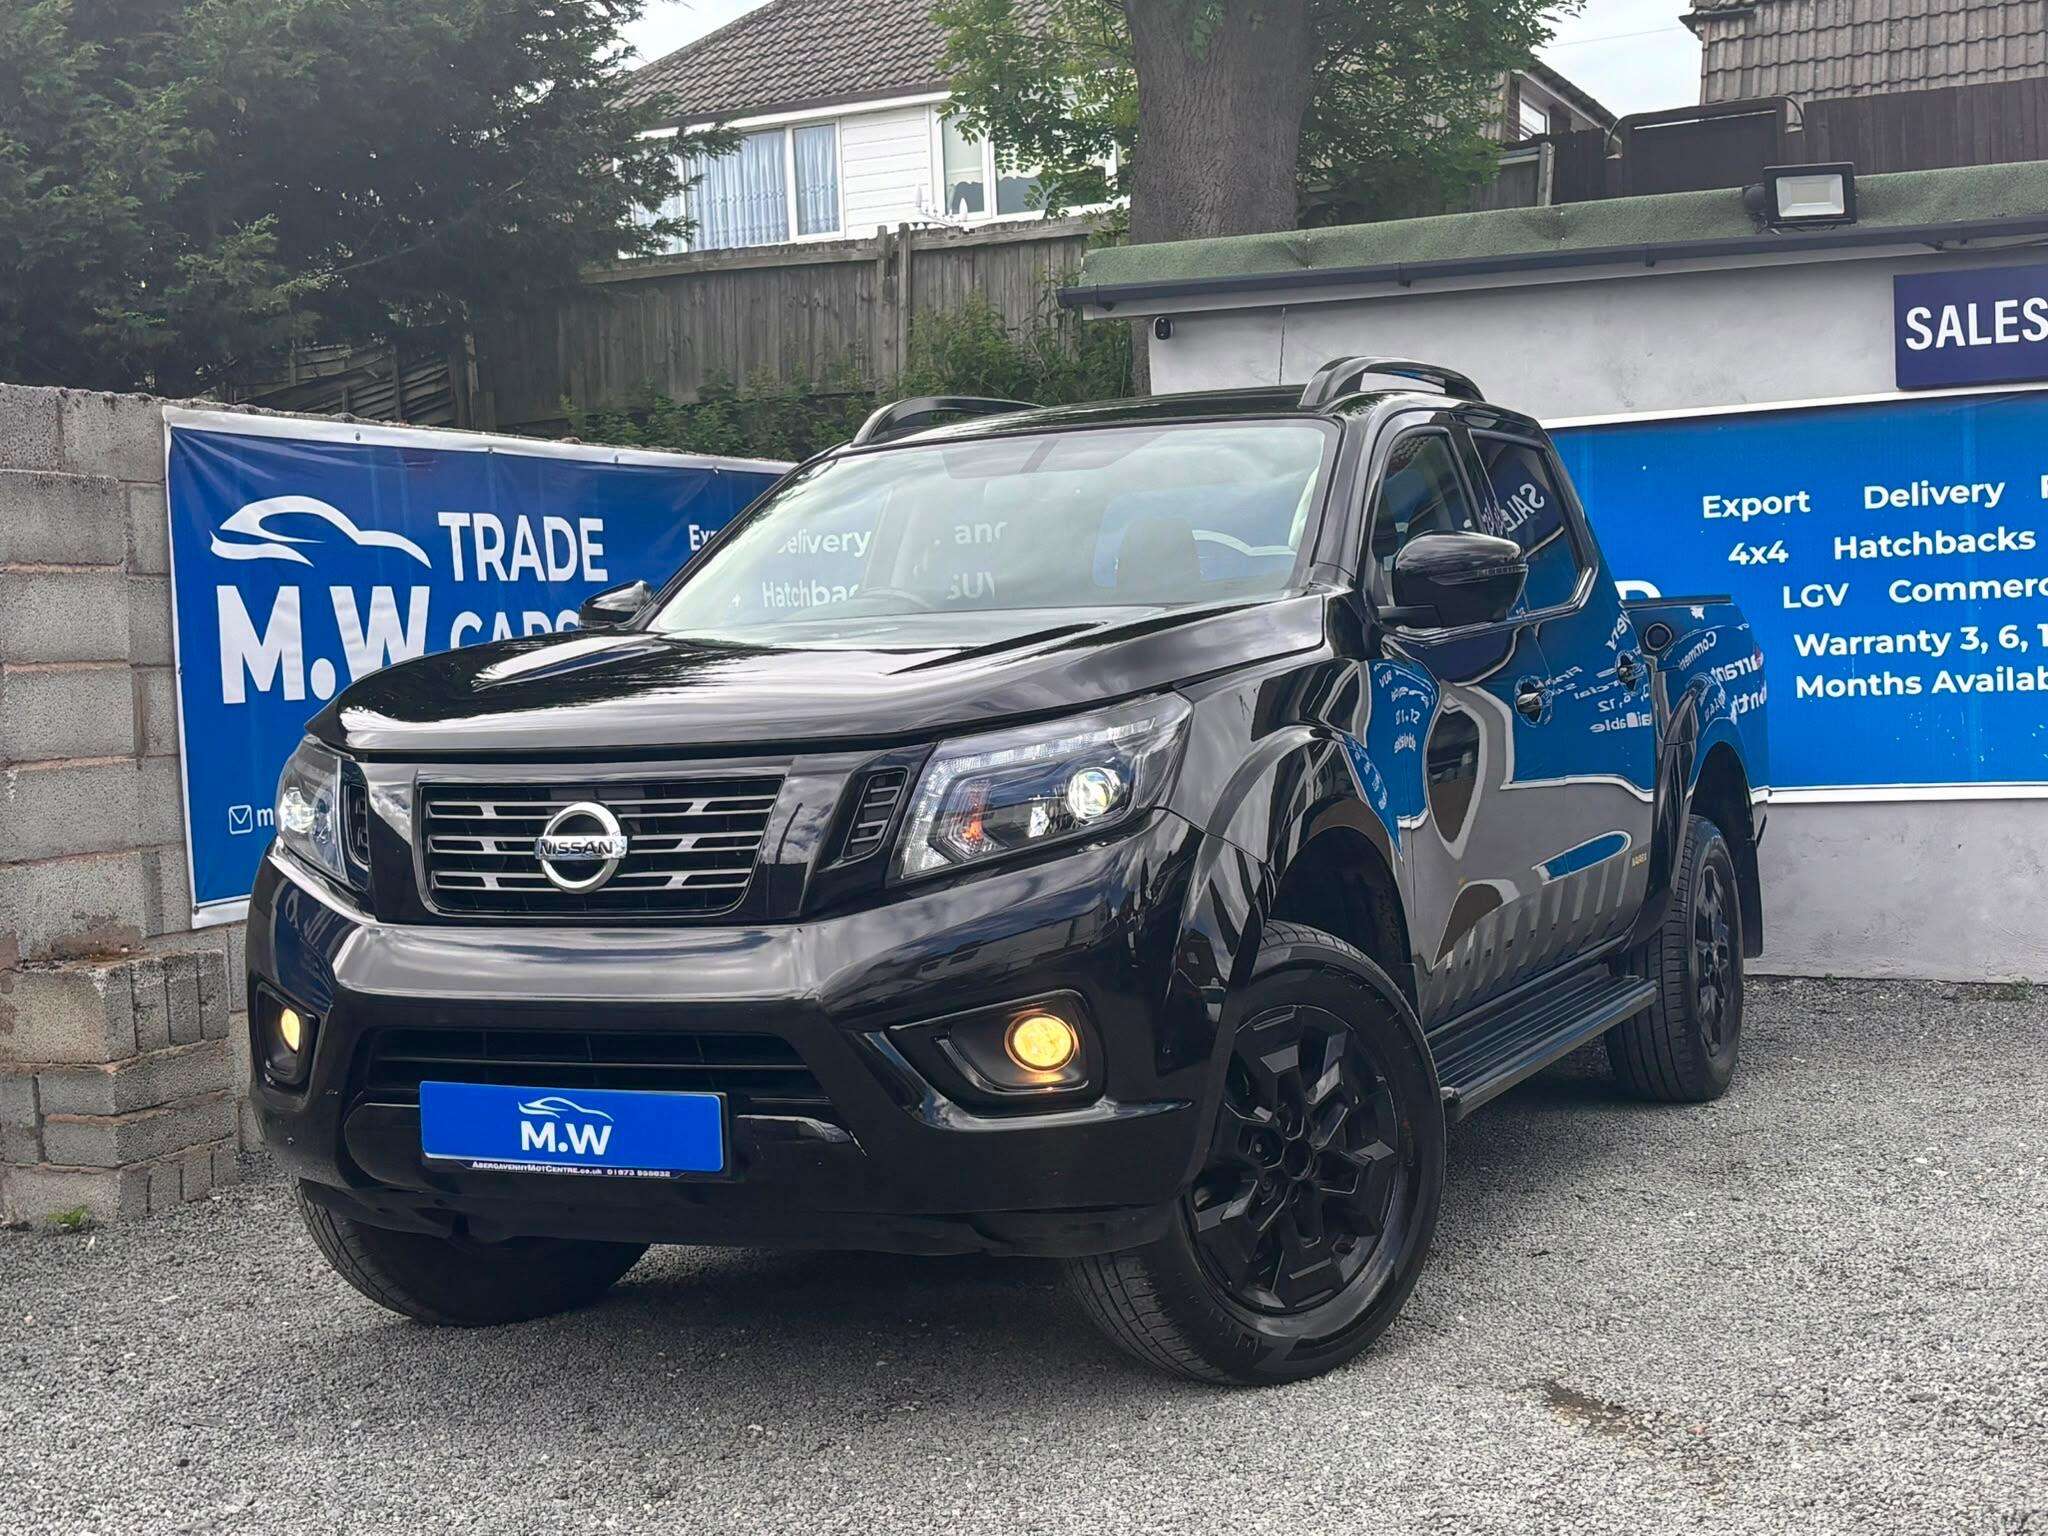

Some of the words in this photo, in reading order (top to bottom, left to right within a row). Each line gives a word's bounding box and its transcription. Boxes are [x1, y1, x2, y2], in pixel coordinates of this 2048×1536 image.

[1905, 297, 2048, 350] SALES
[1703, 491, 1811, 521] Export
[1864, 480, 2005, 509] Delivery
[437, 511, 608, 582] TRADE
[1728, 540, 1789, 565] 4x4
[1834, 526, 2036, 560] Hatchbacks
[1783, 583, 1849, 609] LGV
[216, 586, 430, 704] M.W
[1794, 630, 1950, 658] Warranty
[1960, 626, 1989, 655] 3,
[1998, 624, 2029, 653] 6,
[1796, 671, 1923, 699] Months
[538, 839, 613, 856] NISSAN
[520, 1120, 612, 1156] M.W
